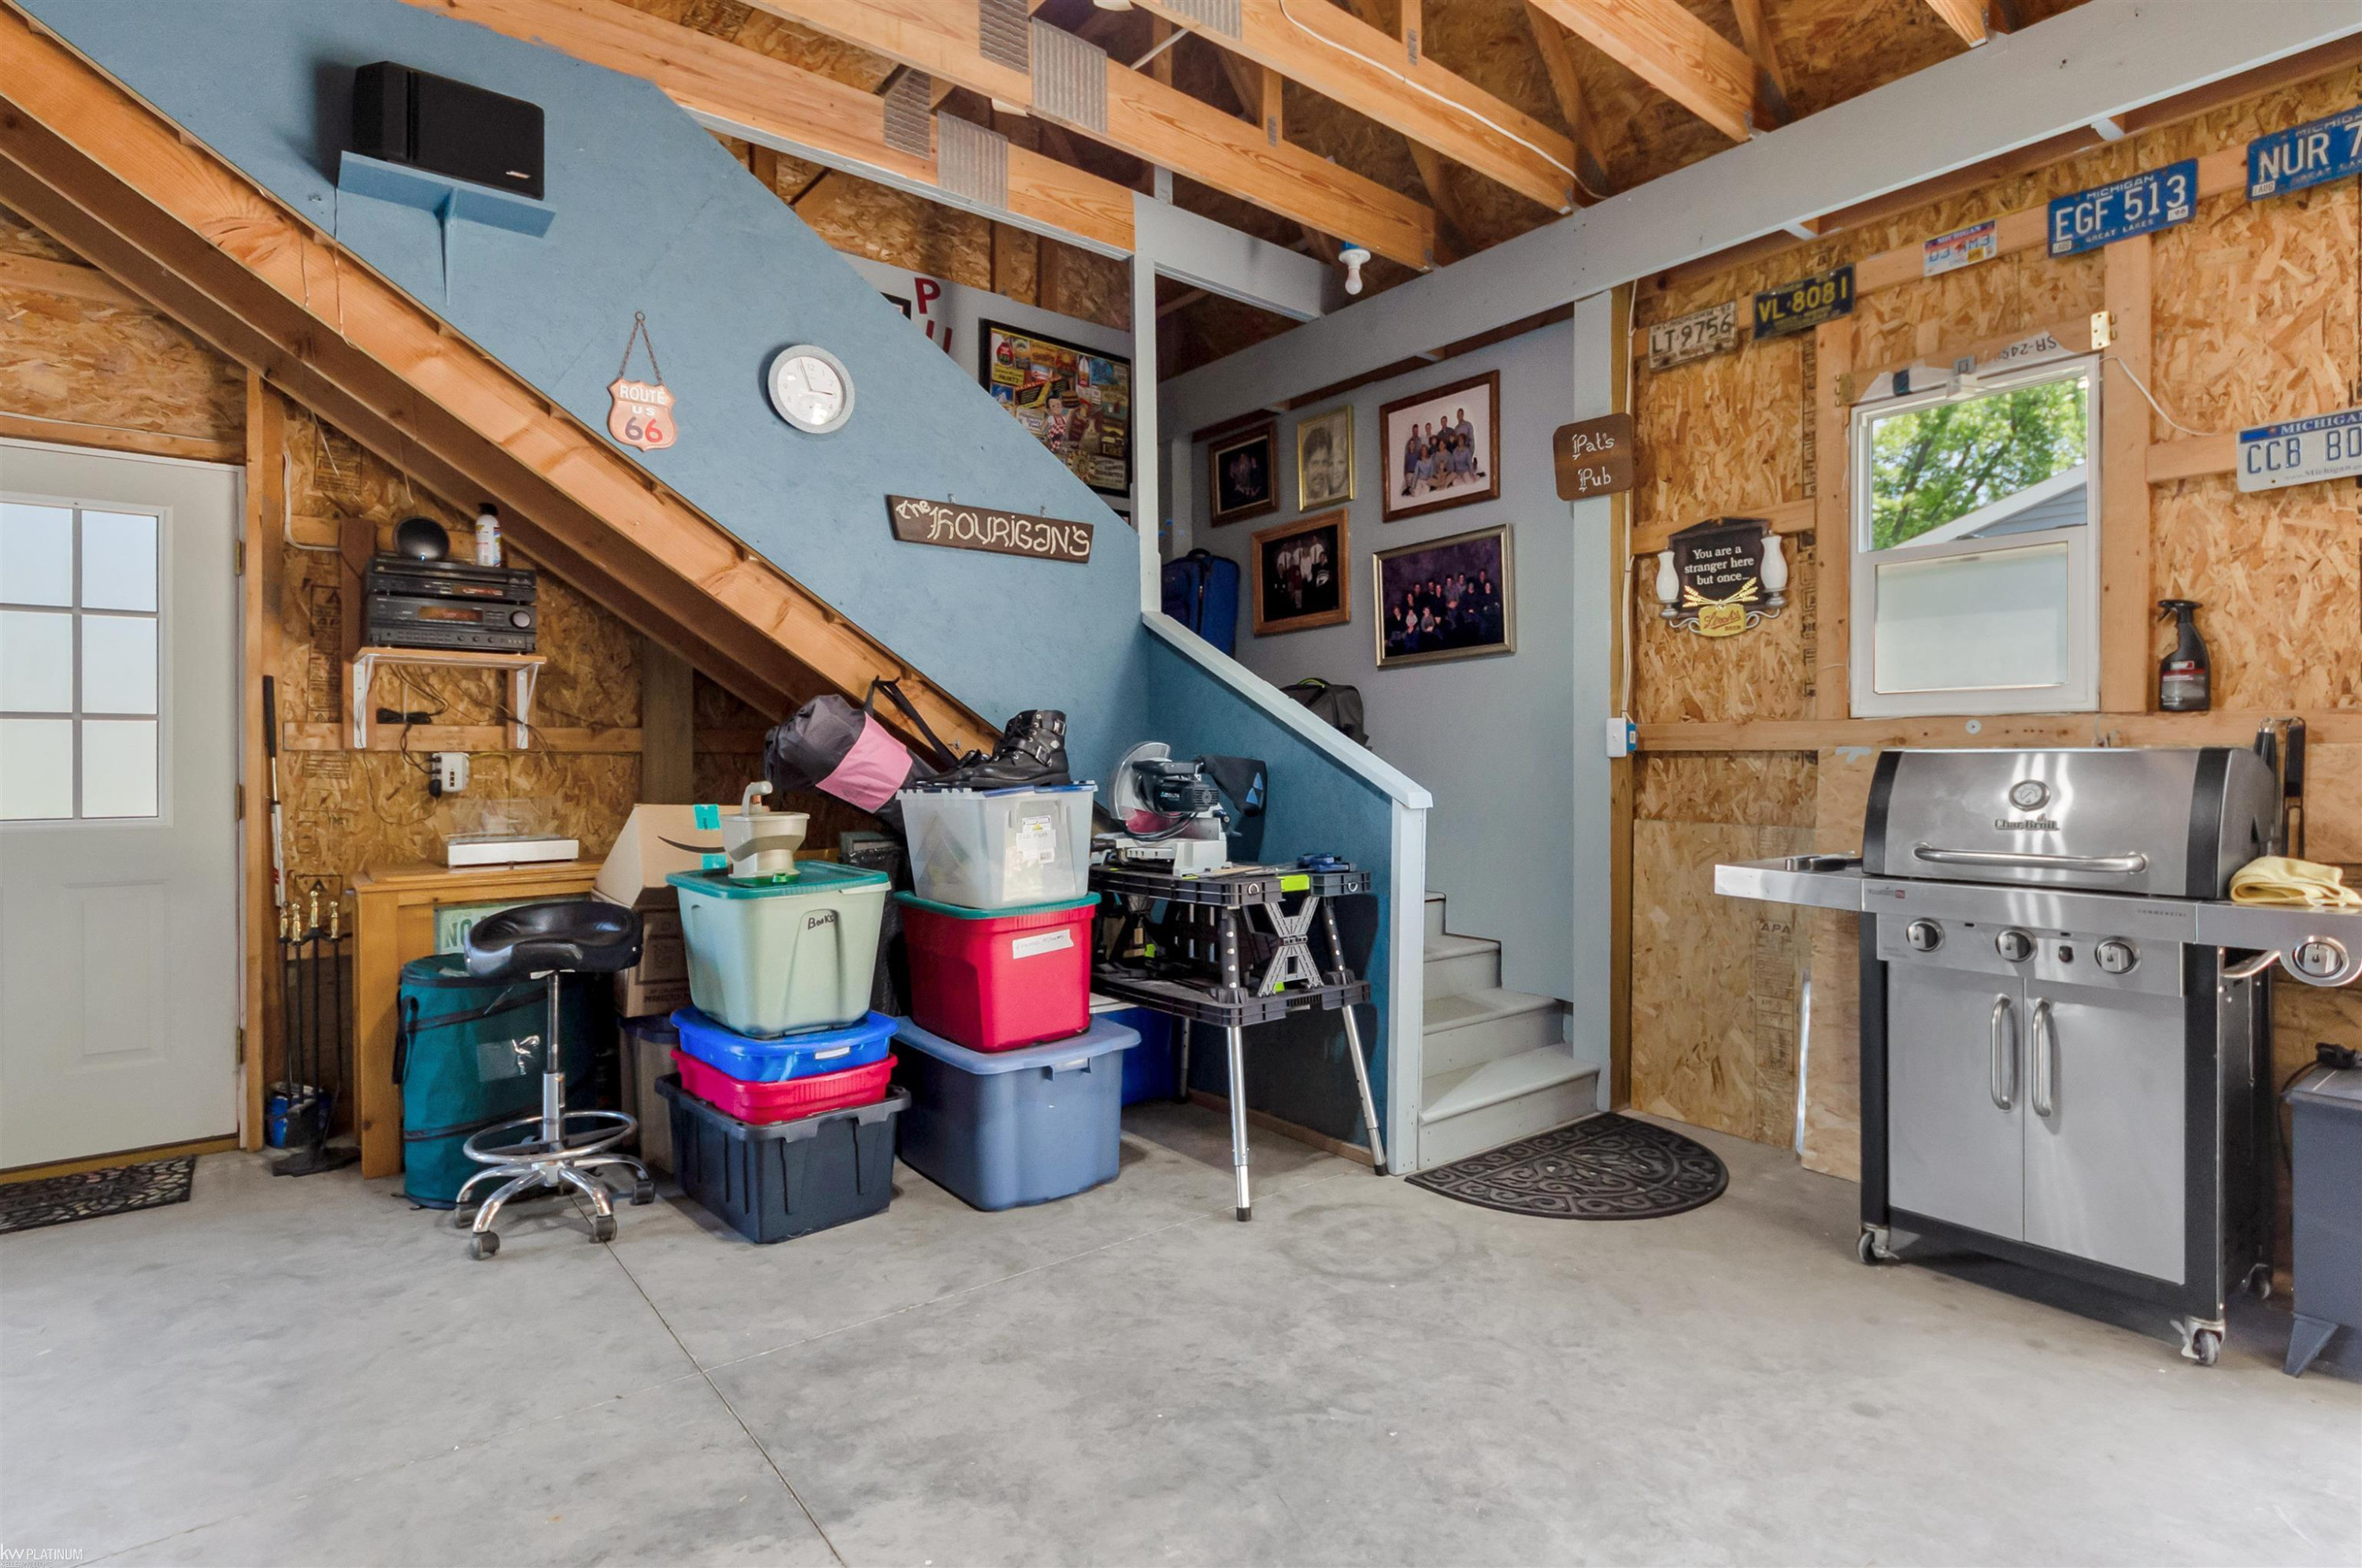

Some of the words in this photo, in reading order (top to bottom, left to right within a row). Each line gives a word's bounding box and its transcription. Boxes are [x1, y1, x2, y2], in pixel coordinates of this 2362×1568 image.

[2259, 132, 2330, 183] NUR
[2086, 175, 2154, 199] MICHIGAN
[2056, 195, 2113, 242] EGF
[2124, 175, 2186, 221] 513
[2086, 229, 2116, 243] GREAT
[2123, 219, 2153, 233] LAKES
[620, 384, 666, 405] ROUTE
[632, 405, 655, 416] US
[625, 416, 663, 443] 66
[2280, 411, 2362, 435] MICHIGA
[1572, 432, 1615, 460] Pat's
[2247, 437, 2301, 475] CCB
[1578, 466, 1612, 493] Pub
[895, 500, 931, 520] The
[1693, 548, 1712, 560] You
[1715, 548, 1732, 557] are
[1734, 545, 1742, 555] a
[1684, 560, 1728, 574] stranger
[1731, 557, 1755, 568] here
[1697, 575, 1714, 586] but
[1760, 923, 1791, 934] APA
